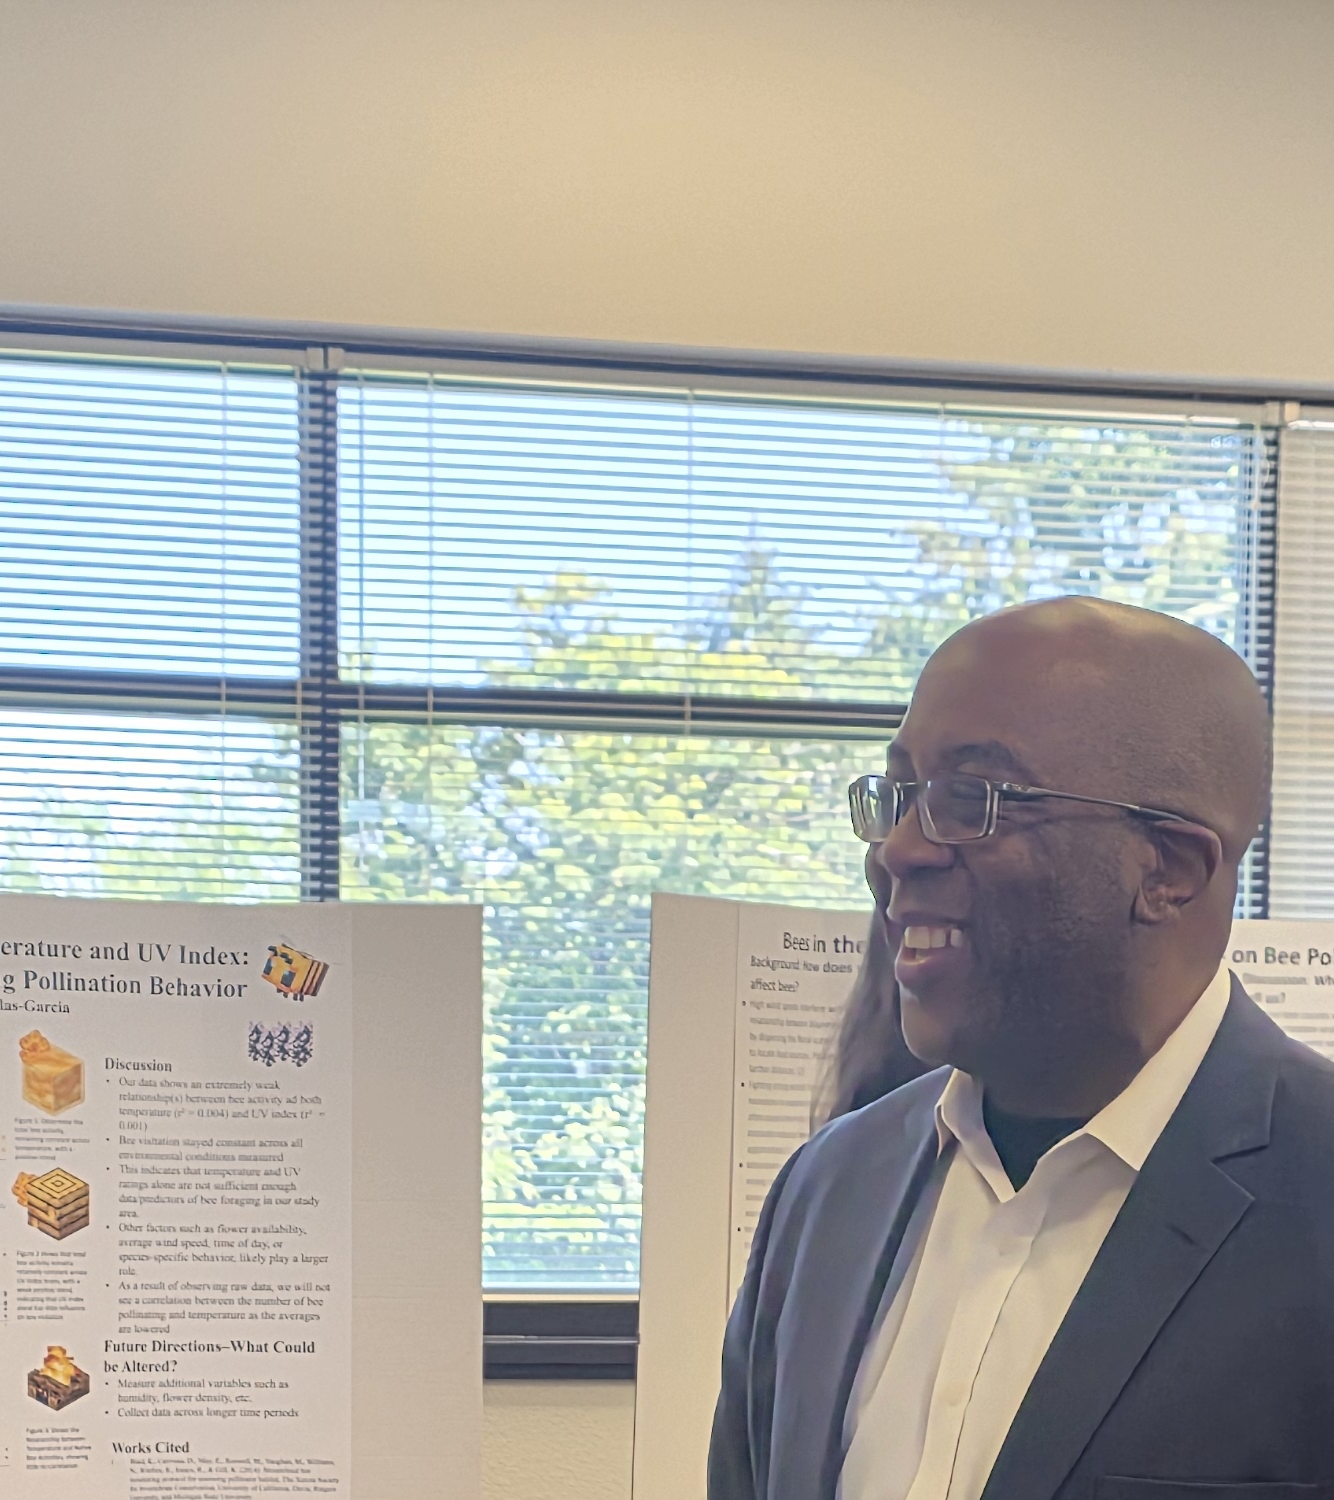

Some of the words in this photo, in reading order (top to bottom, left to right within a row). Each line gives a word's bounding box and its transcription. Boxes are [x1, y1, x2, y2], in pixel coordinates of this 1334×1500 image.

[783, 932, 810, 951] Bees
[813, 935, 826, 952] in
[833, 935, 864, 953] the
[90, 942, 129, 961] and
[138, 943, 171, 962] UV
[180, 945, 248, 965] Index:
[1232, 949, 1257, 964] on
[1264, 947, 1300, 964] Bee
[823, 962, 852, 972] does
[24, 970, 141, 994] Pollination
[150, 977, 248, 997] Behavior
[105, 1058, 172, 1072] Discussion
[105, 1340, 147, 1353] Future
[274, 1341, 315, 1353] Could
[104, 1361, 118, 1372] be
[121, 1360, 177, 1372] Altered?
[112, 1442, 151, 1453] Works
[155, 1442, 190, 1453] Cited
